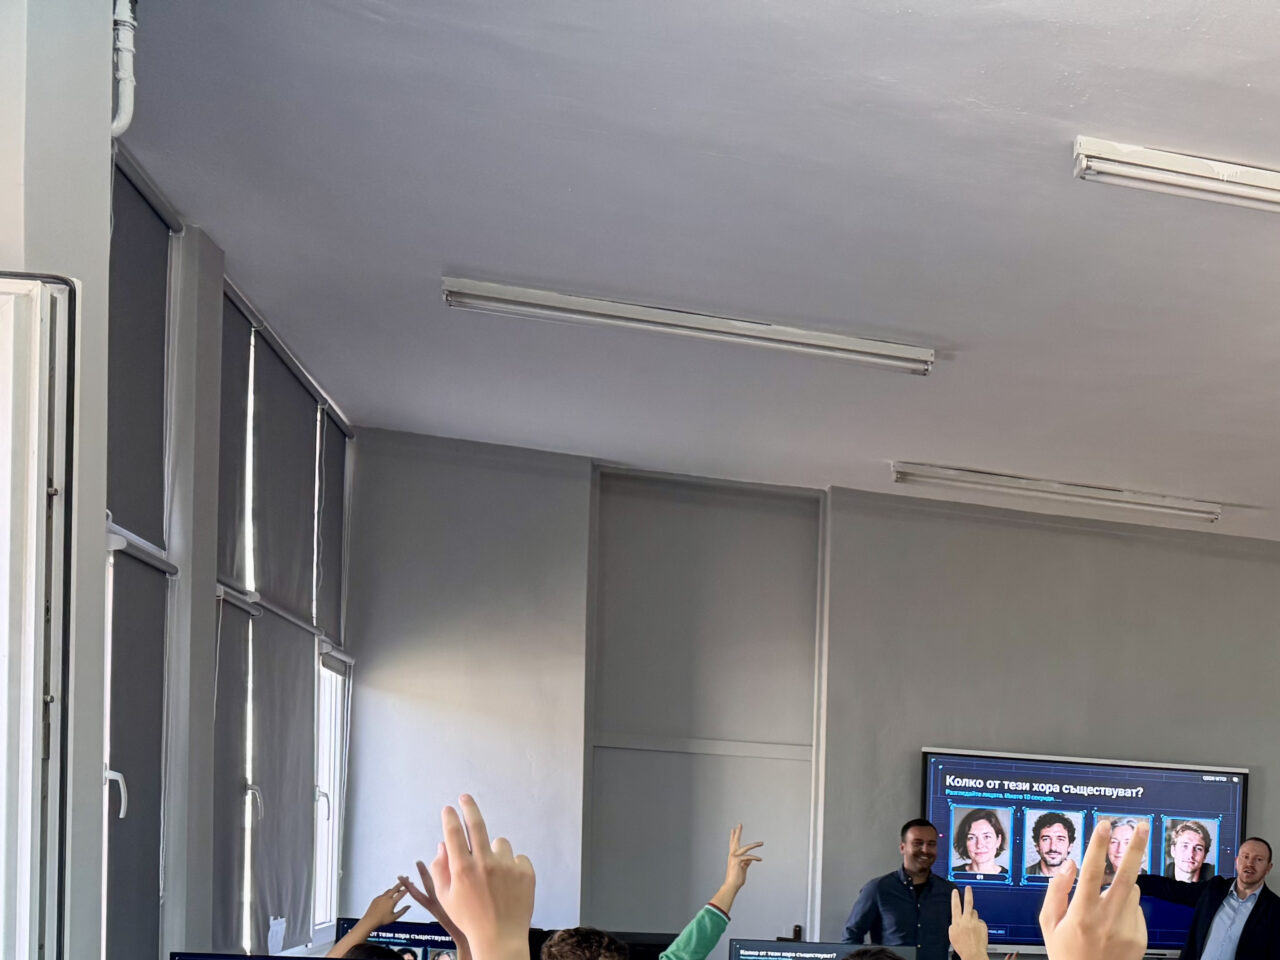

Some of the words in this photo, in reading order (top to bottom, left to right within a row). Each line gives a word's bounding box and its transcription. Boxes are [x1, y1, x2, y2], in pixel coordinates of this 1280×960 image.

[945, 775, 984, 788] Колко
[986, 779, 1001, 789] от
[1002, 780, 1030, 791] тези
[1032, 783, 1060, 794] хора
[1062, 783, 1144, 798] съществуват?
[411, 934, 453, 942] съществуват
